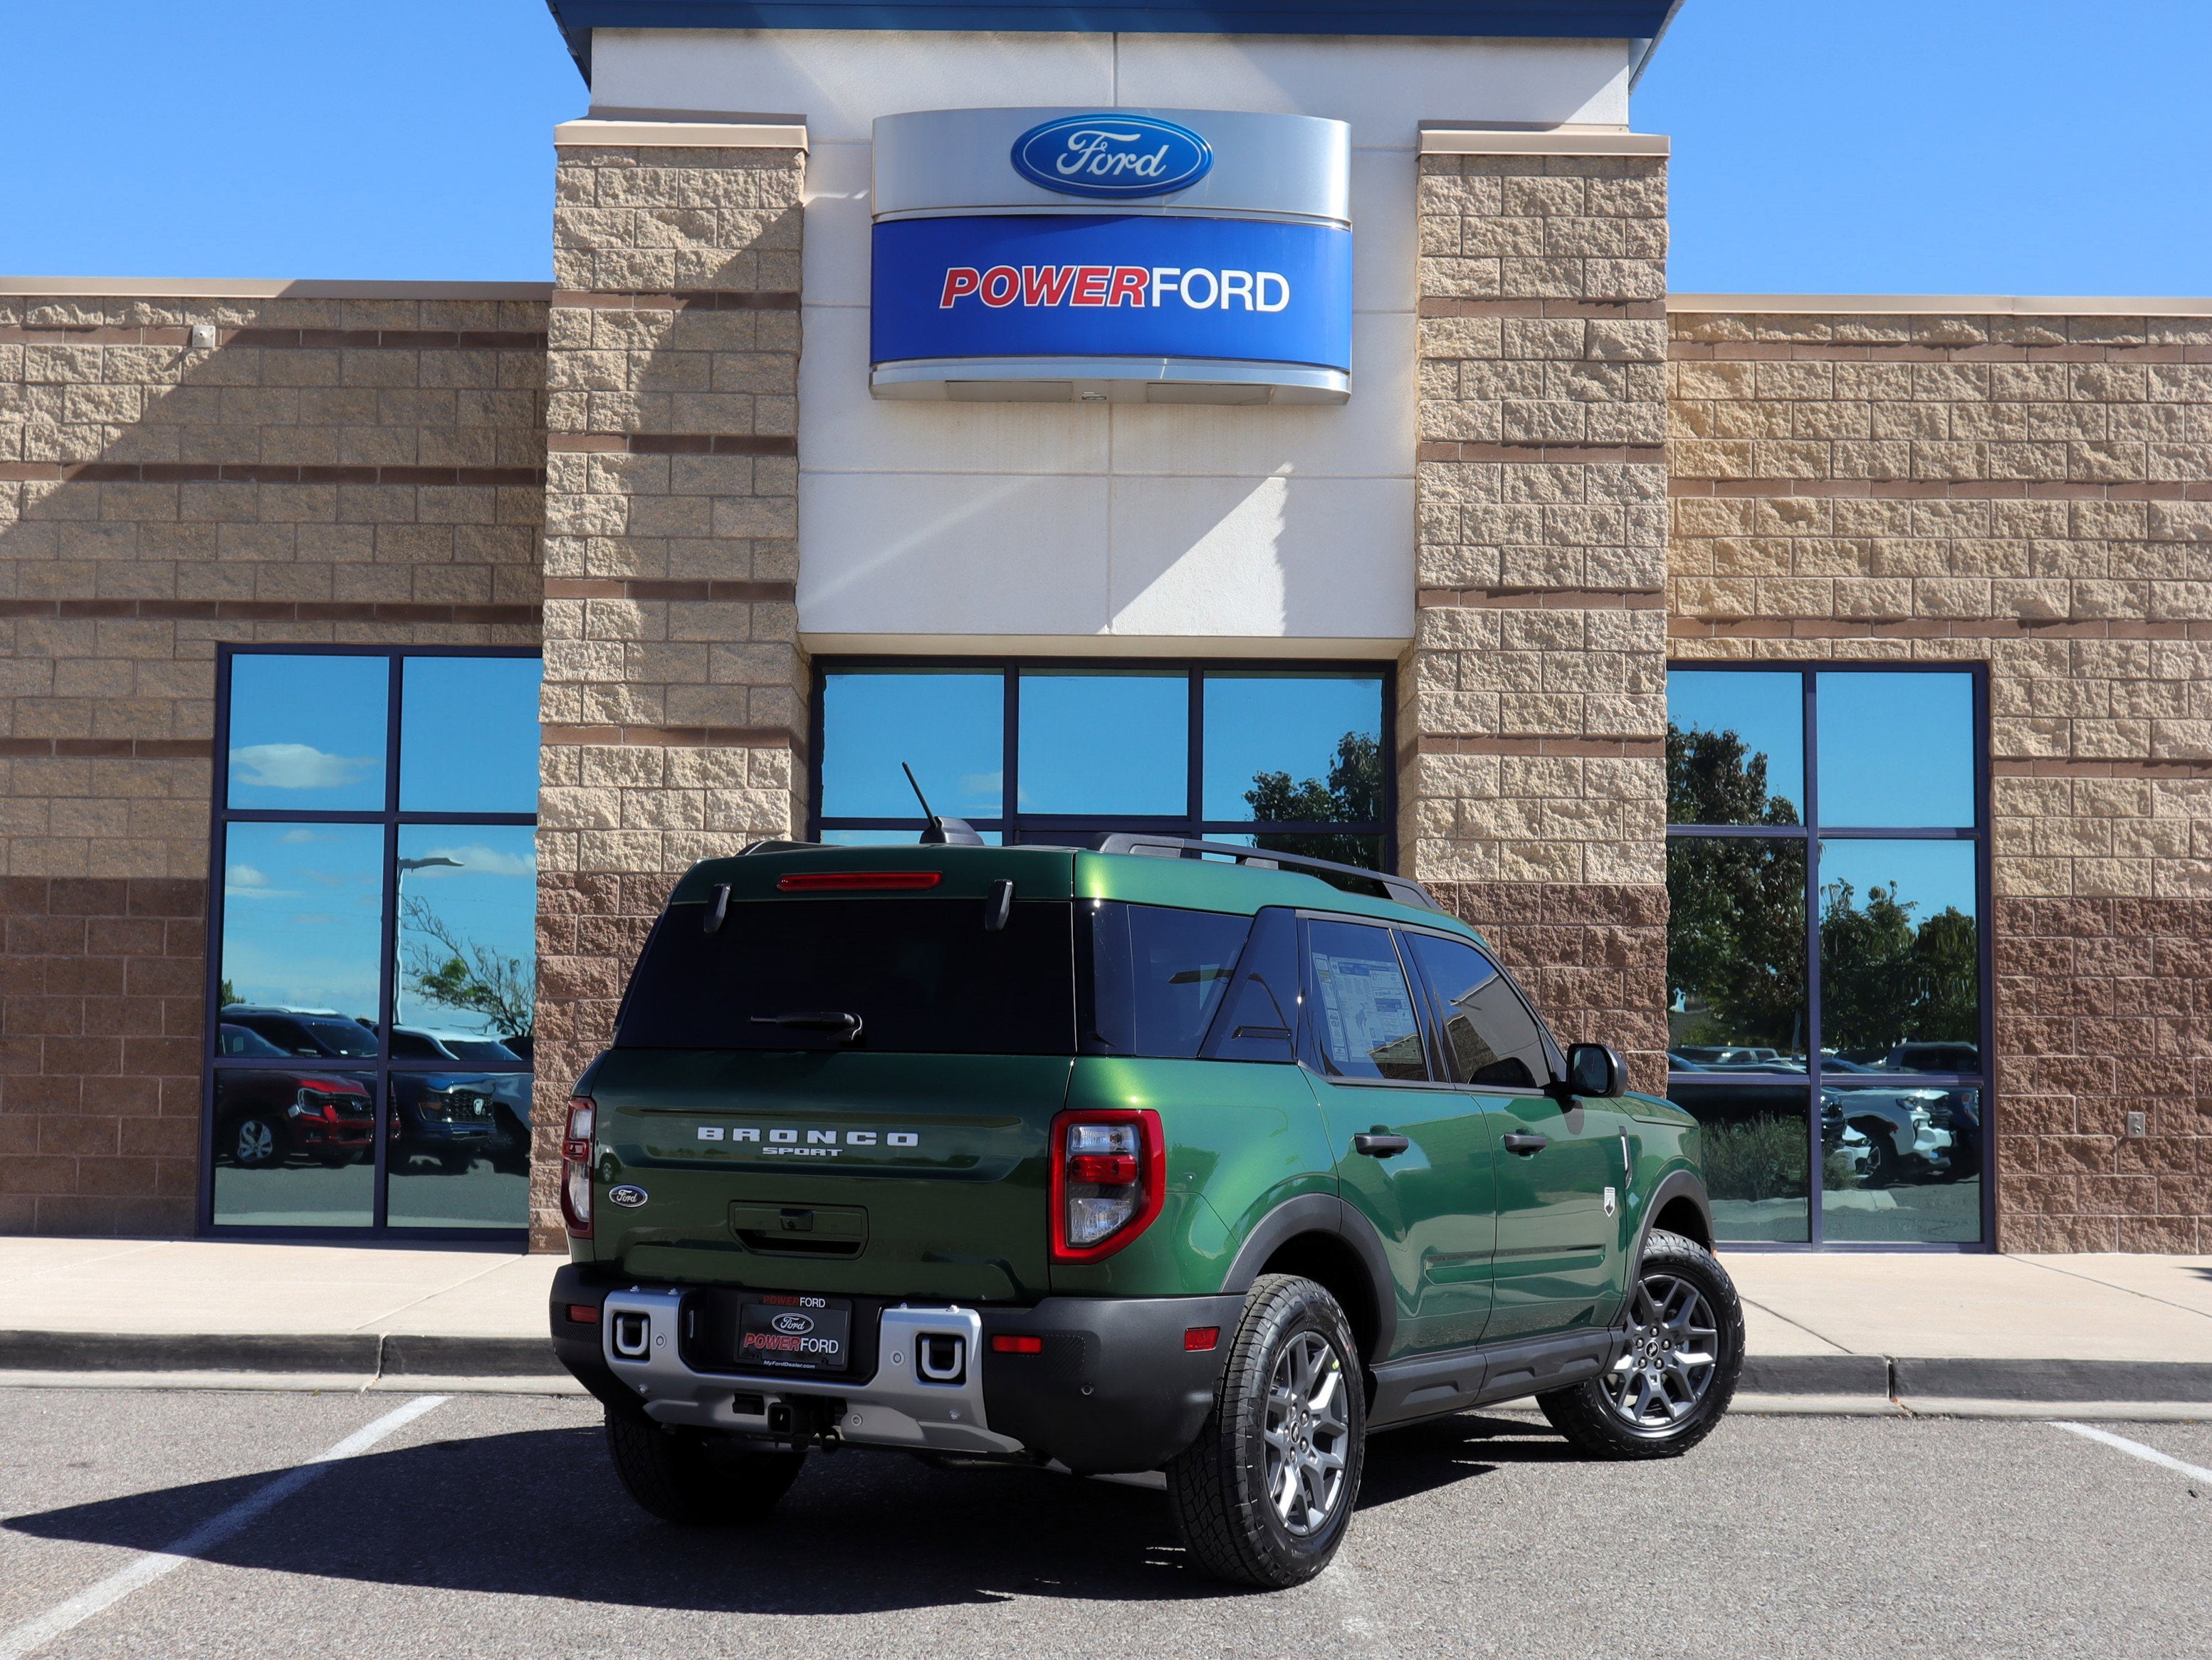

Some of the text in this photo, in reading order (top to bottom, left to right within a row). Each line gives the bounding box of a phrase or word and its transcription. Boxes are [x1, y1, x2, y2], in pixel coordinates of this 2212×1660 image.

[1056, 130, 1168, 177] Ford
[938, 265, 1290, 313] POWERFORD
[697, 1126, 919, 1147] BRONCO
[762, 1147, 843, 1157] SPORT
[616, 1189, 638, 1203] Ford
[763, 1295, 825, 1307] POWERFORD
[780, 1317, 805, 1330] Ford
[743, 1333, 839, 1353] POWERFORD
[763, 1360, 815, 1369] MyFordDealer.com
